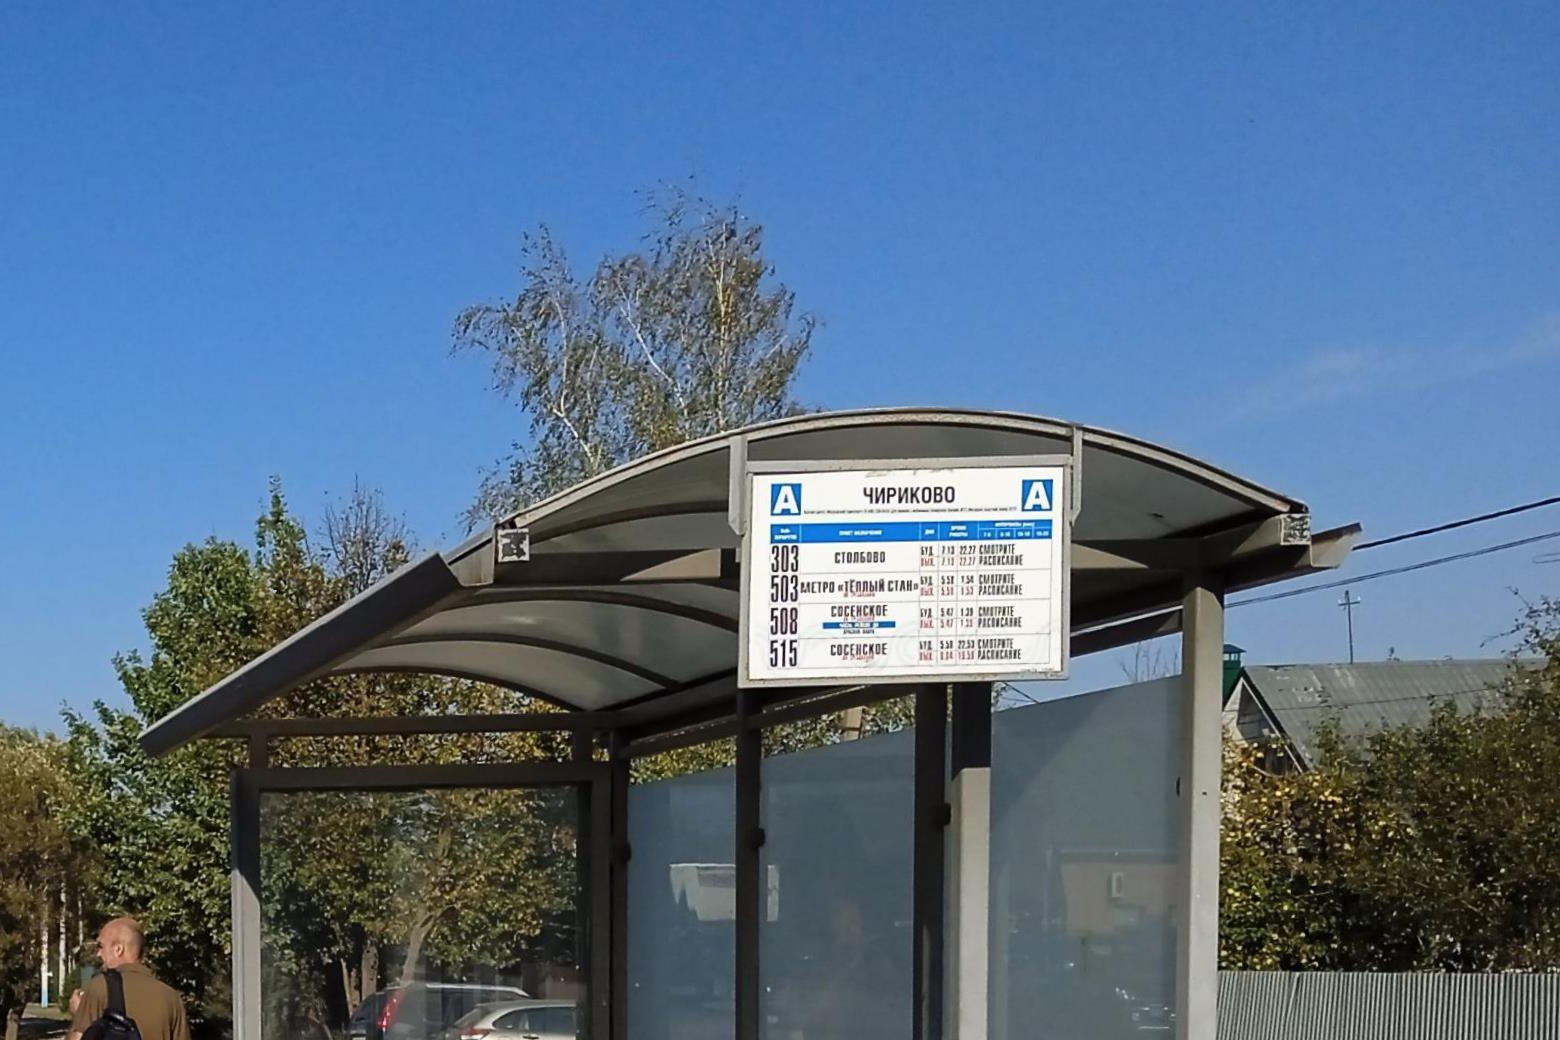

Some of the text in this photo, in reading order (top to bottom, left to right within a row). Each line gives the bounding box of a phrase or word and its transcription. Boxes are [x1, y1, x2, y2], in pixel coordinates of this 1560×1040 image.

[772, 485, 799, 514] А
[863, 486, 956, 505] ЧИРИКОВО
[1023, 481, 1051, 510] А
[770, 545, 799, 573] 303
[834, 551, 886, 564] СТОЛБОВО
[770, 575, 799, 603] 503
[800, 578, 919, 594] МЕТРО «ТЁПЛЫЙ СТАН»
[770, 607, 798, 635] 508
[831, 604, 888, 617] СОСЕНСКОЕ
[770, 639, 798, 667] 515
[830, 642, 888, 656] СОСЕНСКОЕ
